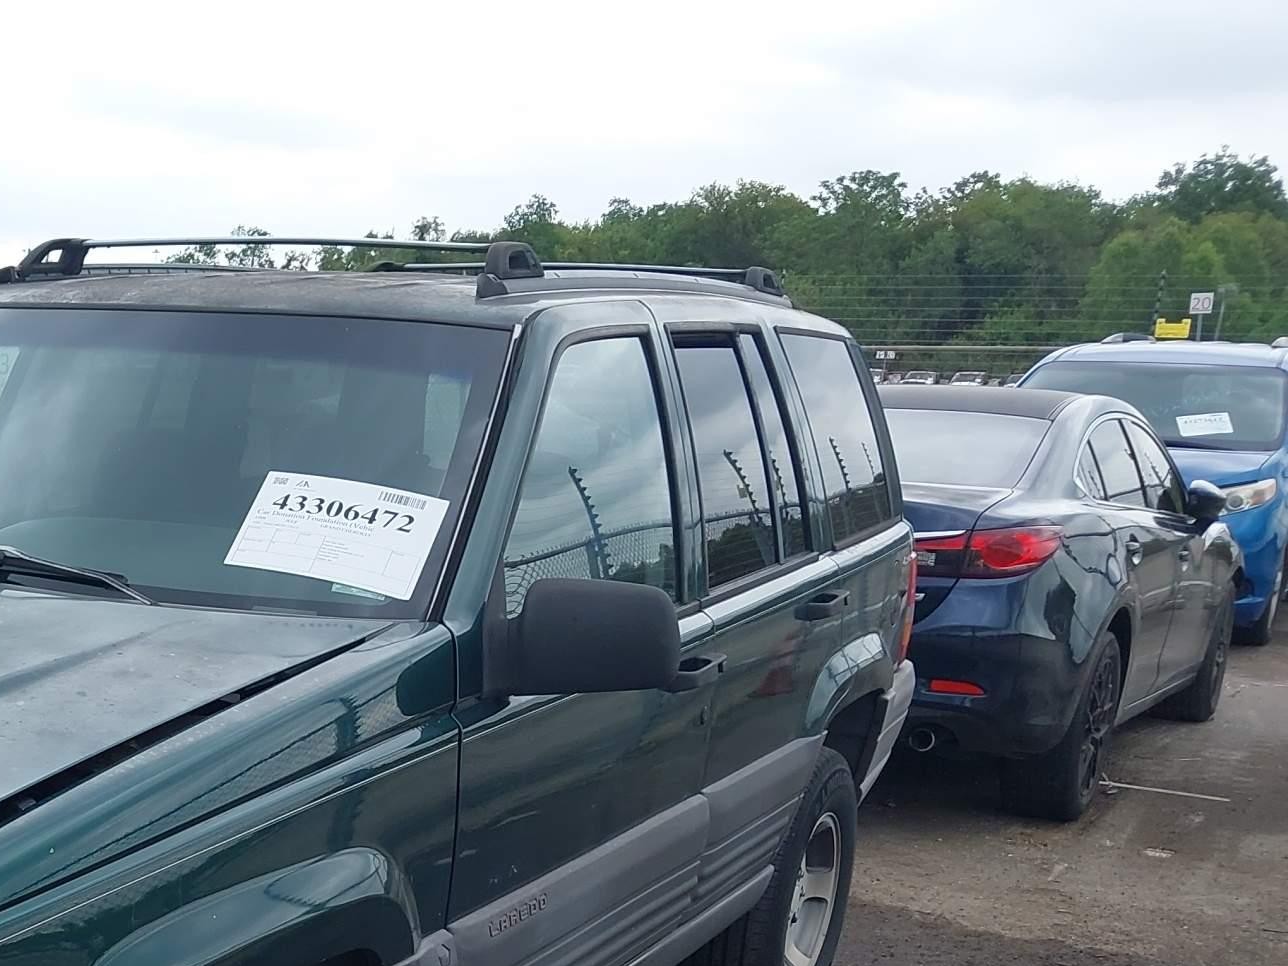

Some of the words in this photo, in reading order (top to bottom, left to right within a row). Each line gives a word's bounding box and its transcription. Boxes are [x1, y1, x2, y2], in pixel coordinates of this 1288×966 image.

[1192, 296, 1212, 310] 20
[272, 493, 415, 533] 43306472
[488, 892, 548, 937] LAREDO
